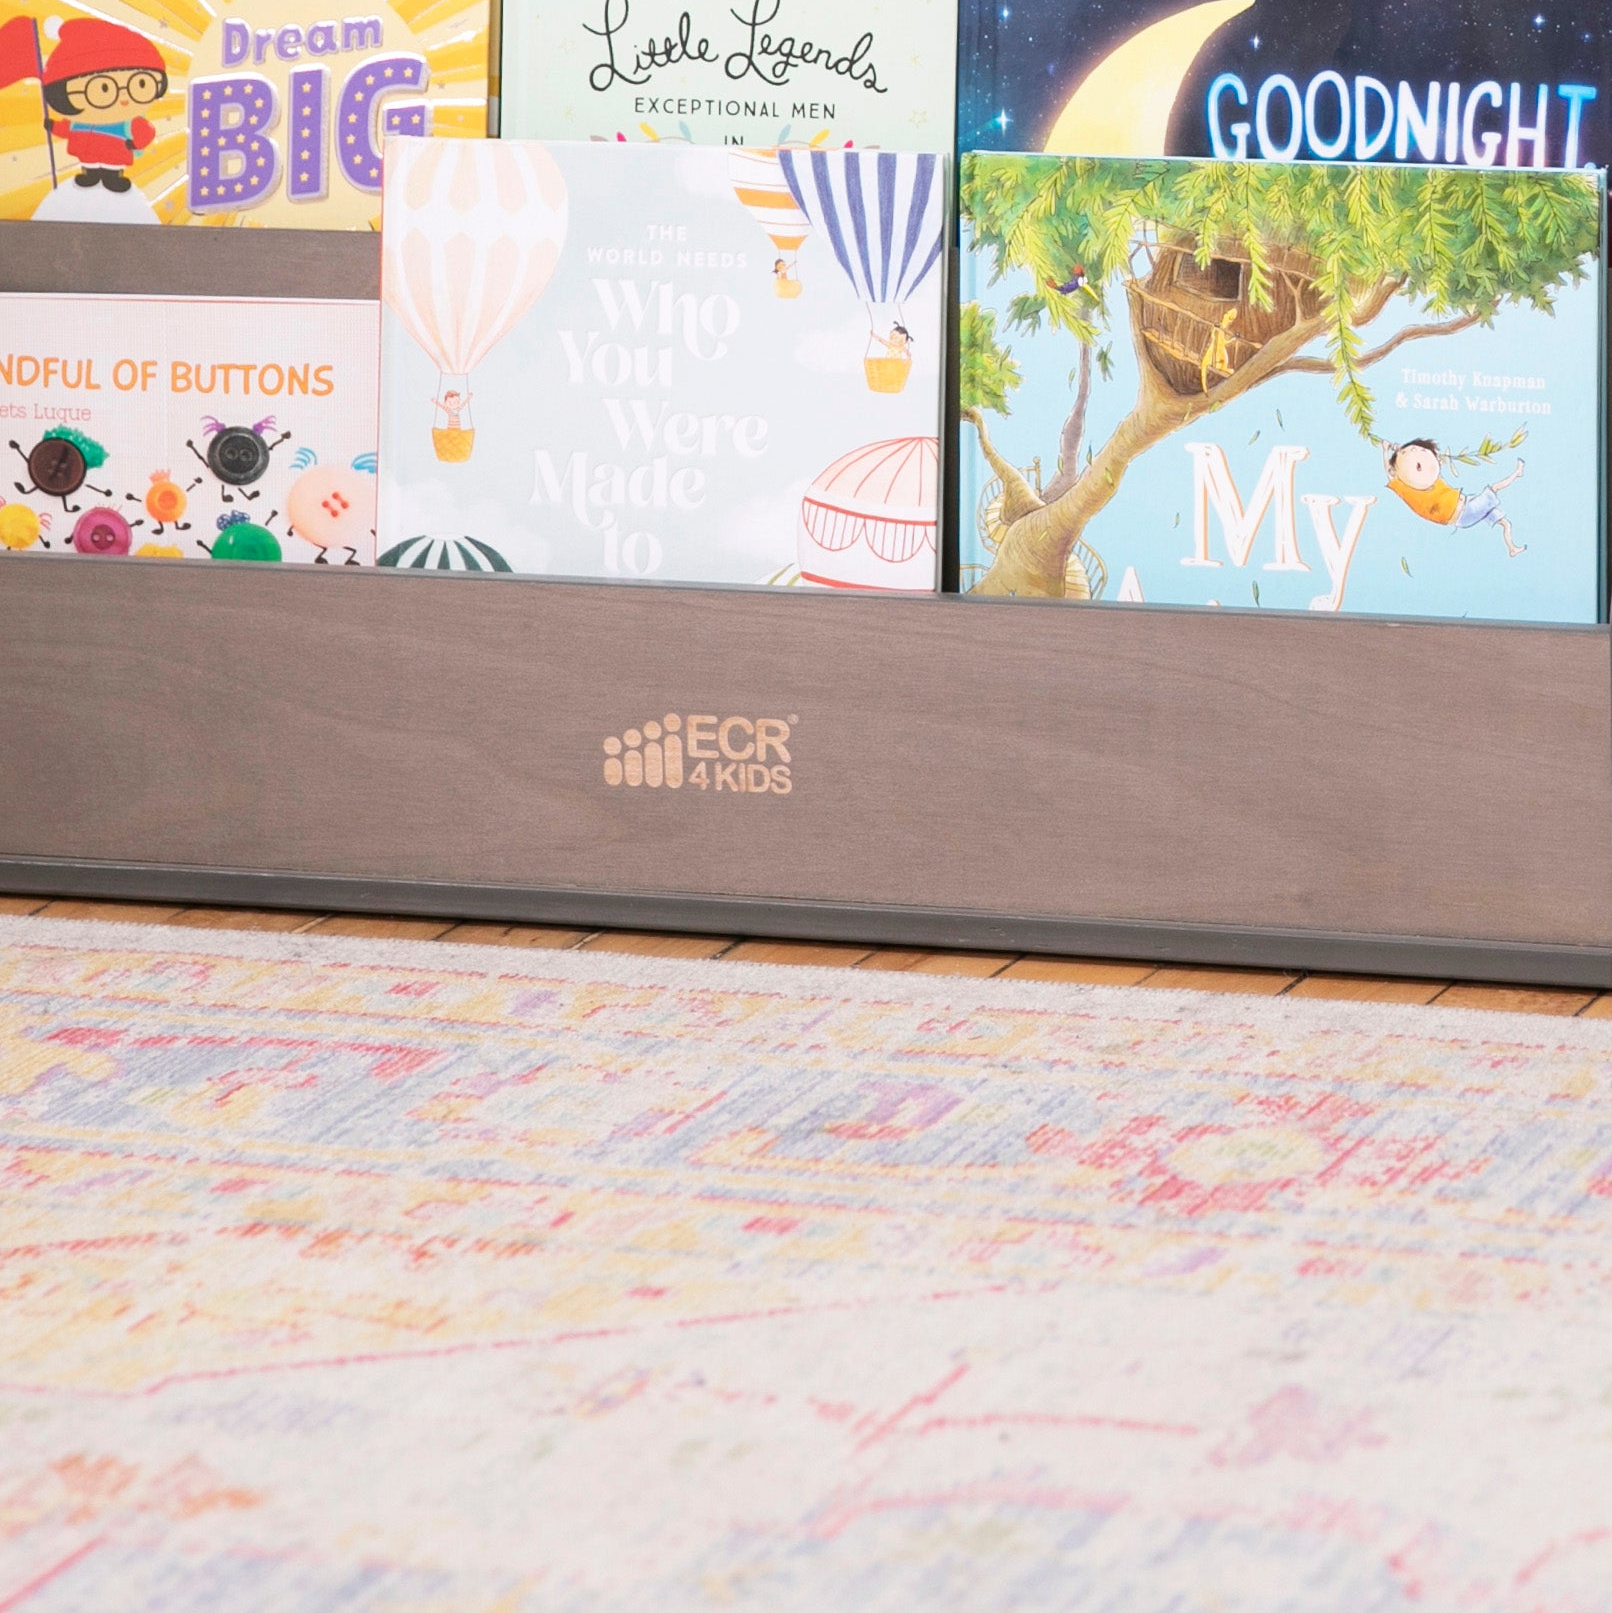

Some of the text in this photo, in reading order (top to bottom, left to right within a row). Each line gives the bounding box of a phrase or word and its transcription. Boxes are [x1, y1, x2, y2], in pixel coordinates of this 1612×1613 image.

[221, 15, 383, 68] Dream
[188, 51, 432, 214] BIG
[634, 97, 836, 119] EXCEPTIONAL MEN
[586, 247, 747, 268] WORLD NEEDS
[647, 225, 687, 241] THE
[591, 278, 741, 362] Who
[112, 359, 158, 391] OF
[171, 361, 335, 396] BUTTONS
[557, 330, 673, 387] You
[1401, 368, 1546, 393] Timothy Knapman
[34, 404, 92, 424] Luque
[602, 397, 769, 458] Were
[1395, 391, 1552, 414] & Sarah Warburton
[528, 450, 706, 530] Made
[602, 520, 663, 576] to
[1180, 442, 1378, 612] My
